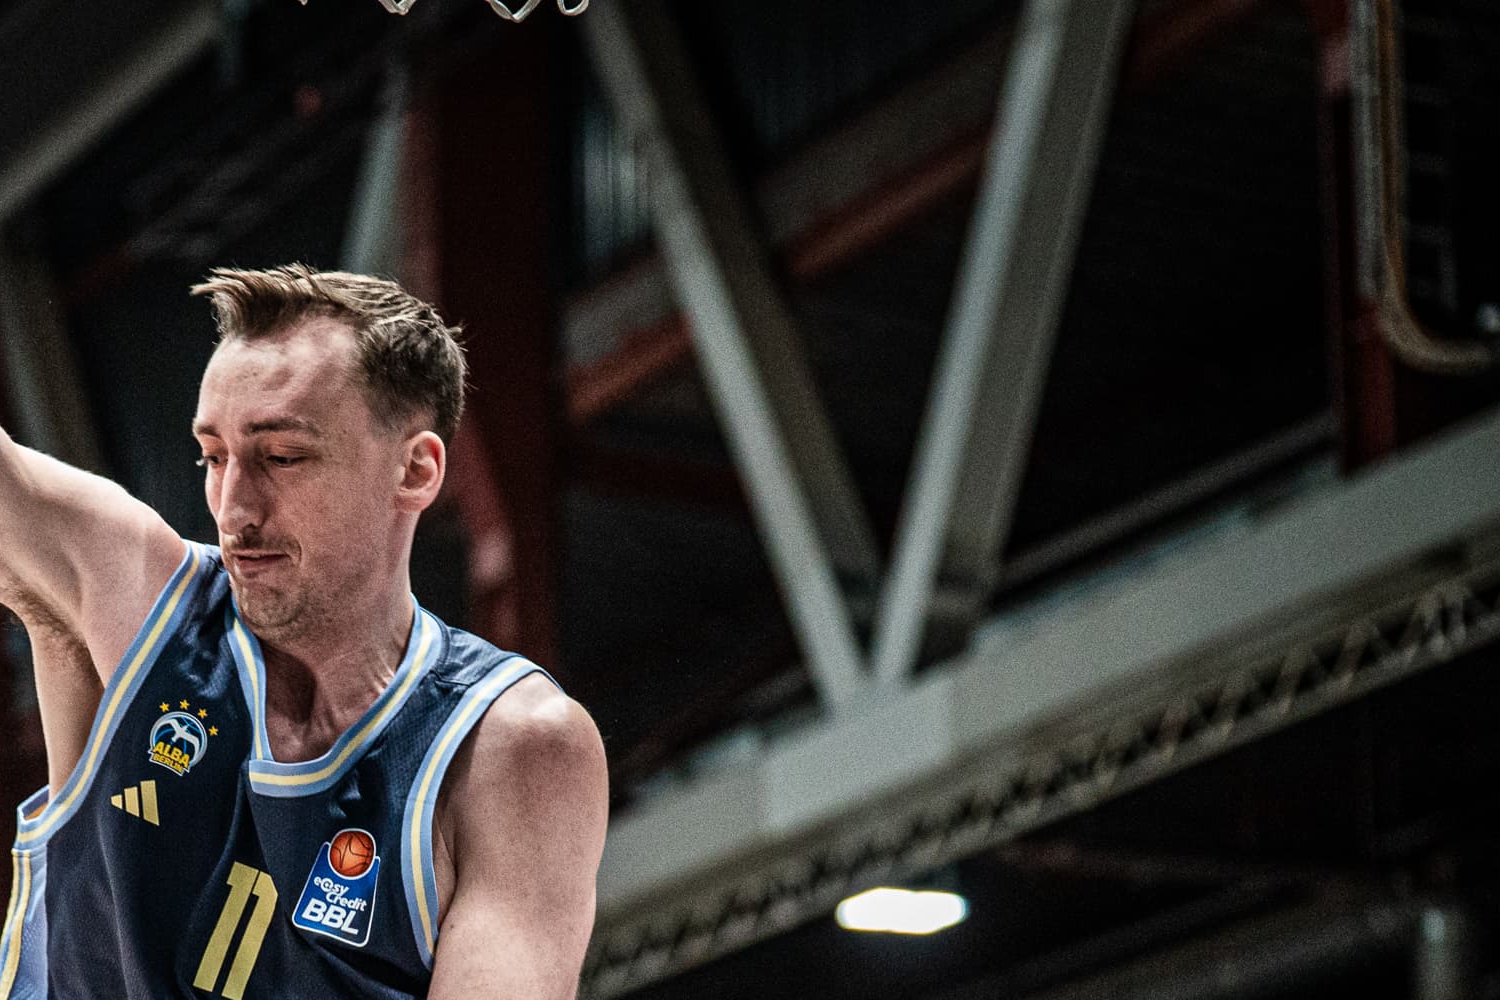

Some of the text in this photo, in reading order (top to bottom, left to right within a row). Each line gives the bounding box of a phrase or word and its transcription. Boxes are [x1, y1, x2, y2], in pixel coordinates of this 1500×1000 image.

[153, 741, 189, 768] ALBA
[326, 892, 367, 911] Credit
[302, 898, 359, 935] BBL
